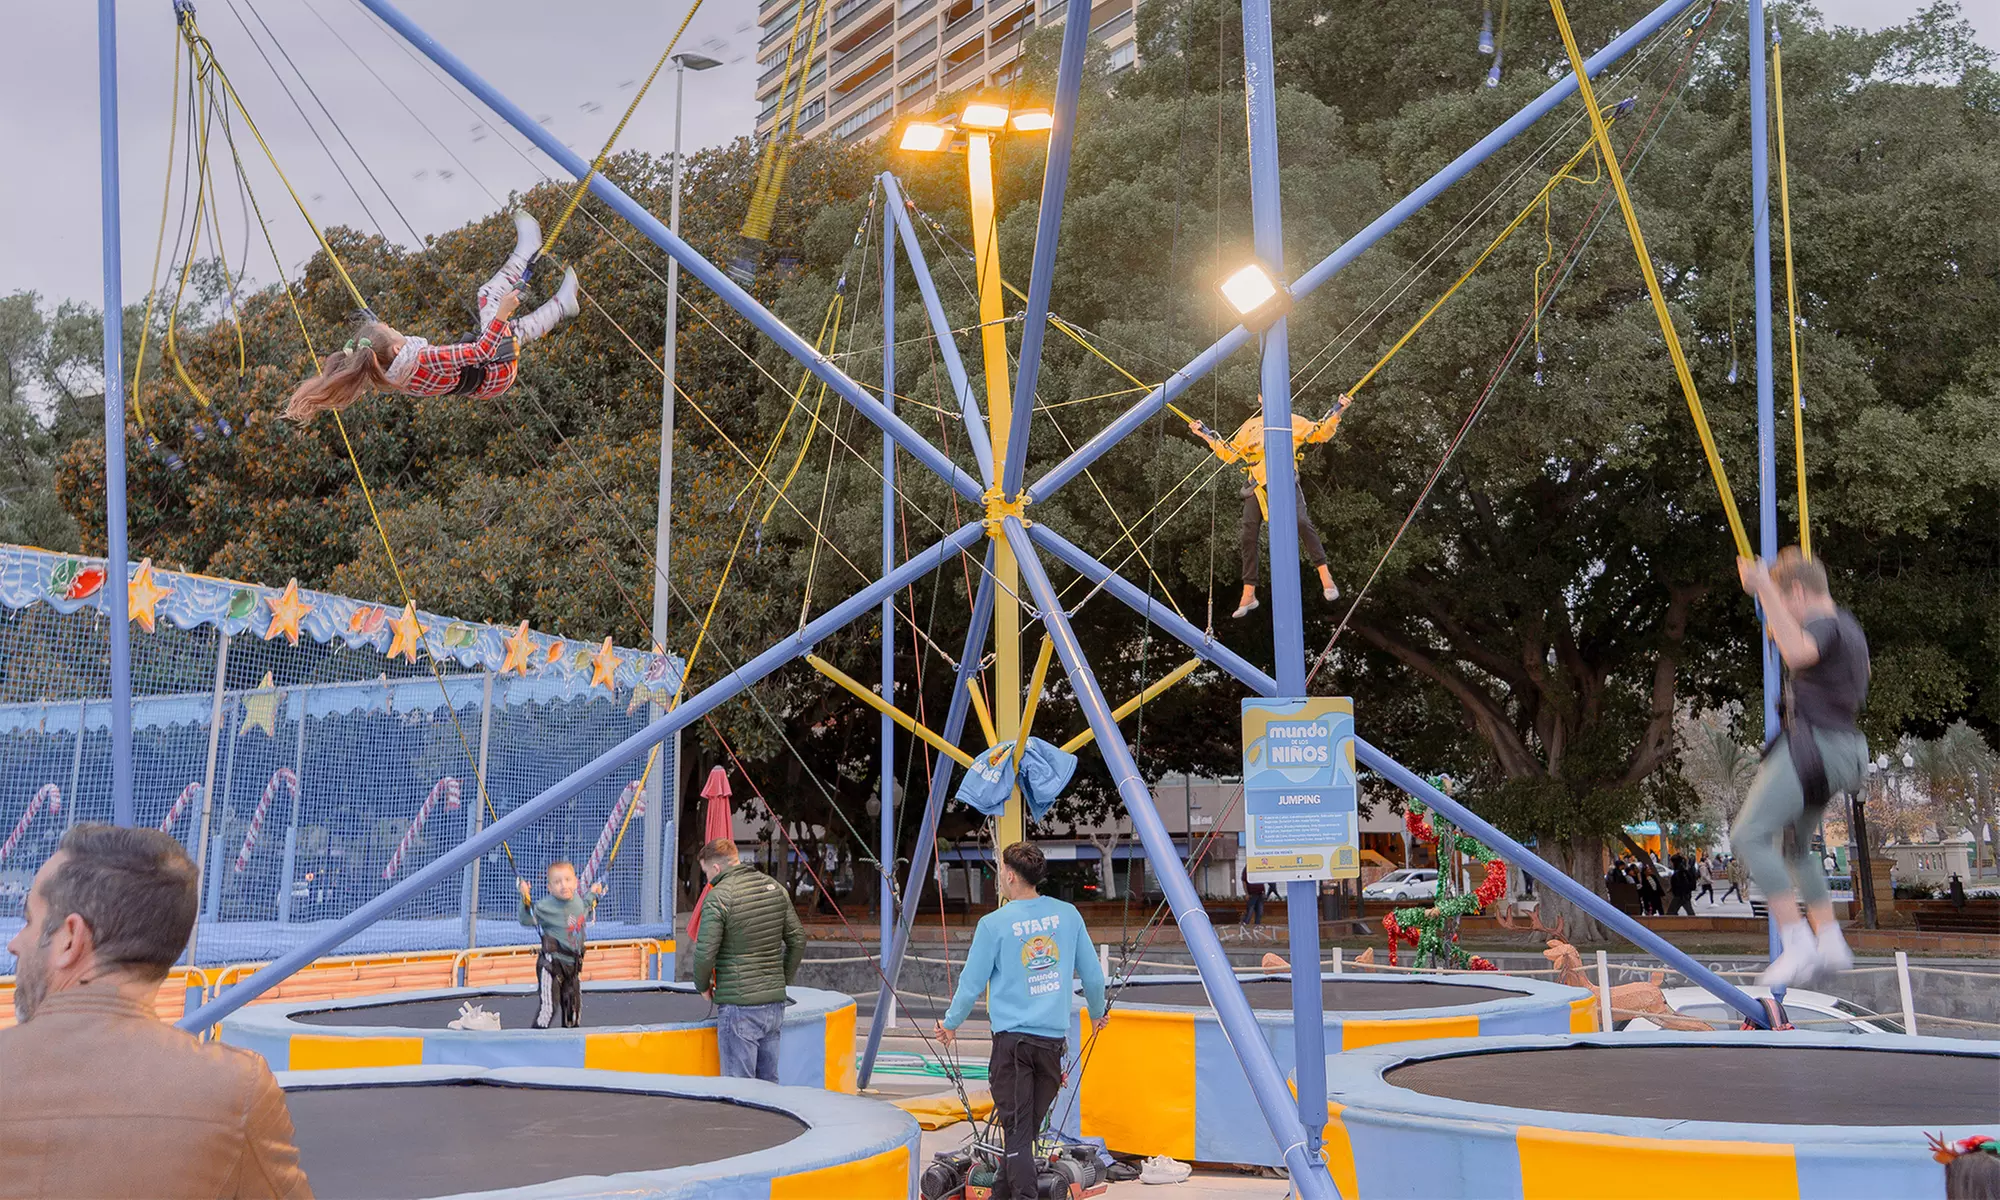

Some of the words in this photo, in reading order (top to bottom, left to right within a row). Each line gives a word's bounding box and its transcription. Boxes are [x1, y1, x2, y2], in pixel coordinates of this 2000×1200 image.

[1270, 722, 1327, 738] mundo
[1272, 745, 1328, 763] NIÑOS
[1278, 795, 1321, 806] JUMPING
[1012, 914, 1060, 937] STAFF
[1028, 970, 1058, 983] mundo
